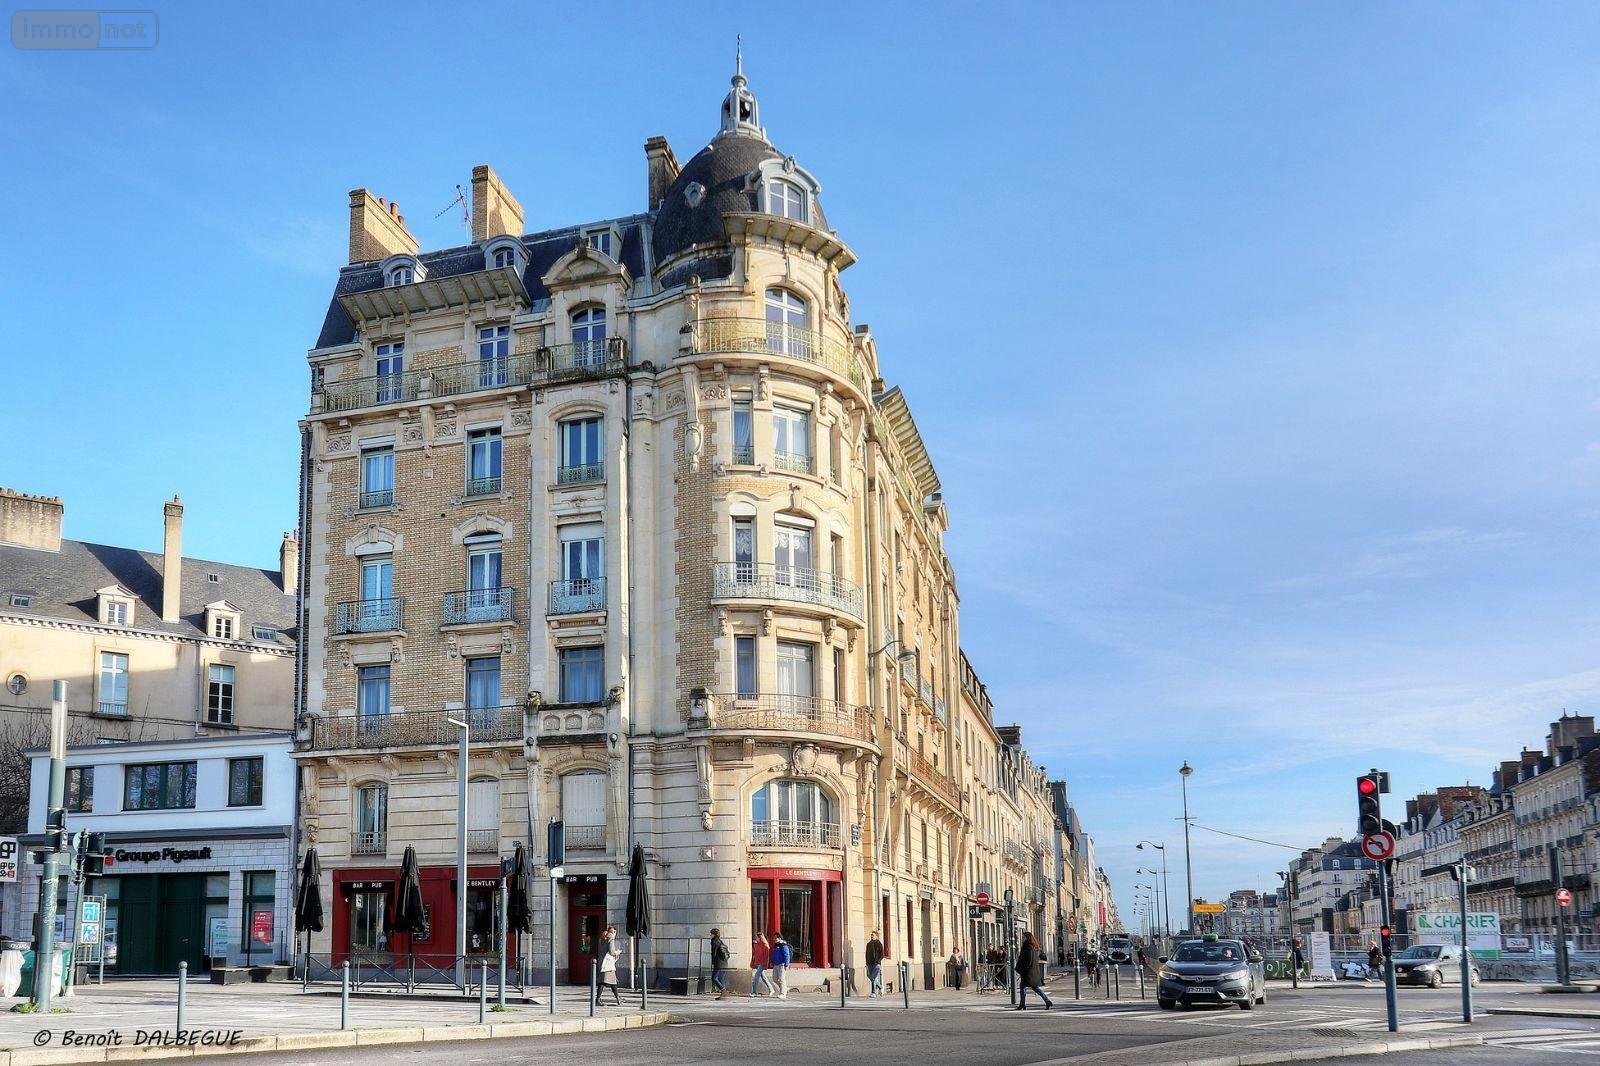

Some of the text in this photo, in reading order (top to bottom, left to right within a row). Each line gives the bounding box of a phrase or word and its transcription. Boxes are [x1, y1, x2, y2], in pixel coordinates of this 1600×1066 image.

[115, 846, 212, 864] Groupe Pigeault
[1434, 914, 1497, 929] CHARIER
